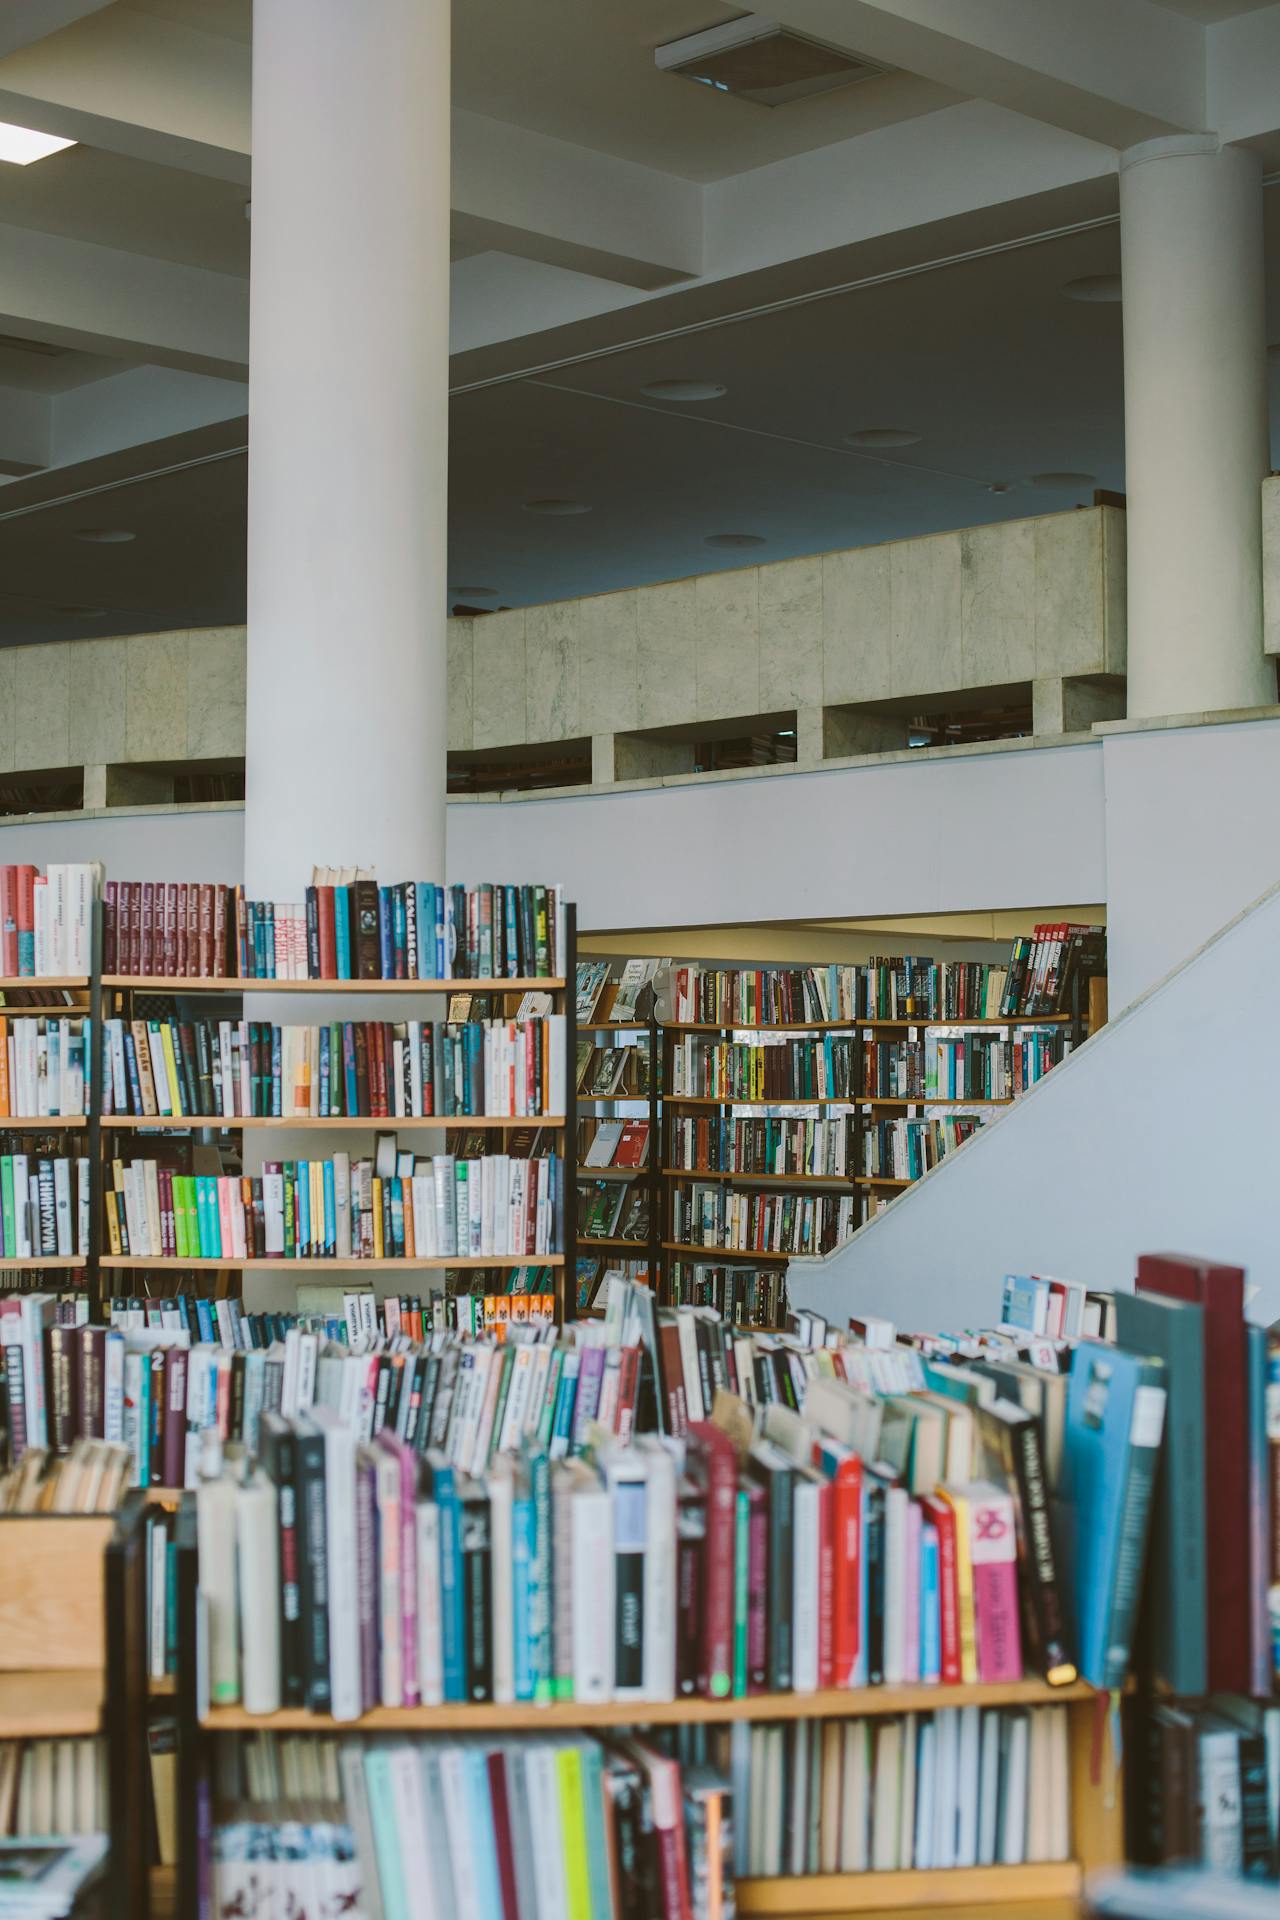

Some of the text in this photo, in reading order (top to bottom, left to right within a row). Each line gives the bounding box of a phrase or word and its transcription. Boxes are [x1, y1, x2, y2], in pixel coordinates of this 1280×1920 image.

[274, 919, 288, 964] РУБИНА
[406, 884, 416, 966] ФИРМА
[422, 1042, 431, 1082] СОРОКИН
[40, 1181, 55, 1248] МАКАНИН
[151, 1351, 164, 1370] 2
[1020, 1428, 1053, 1581] ИСТОРИЯ КОСТЮМА
